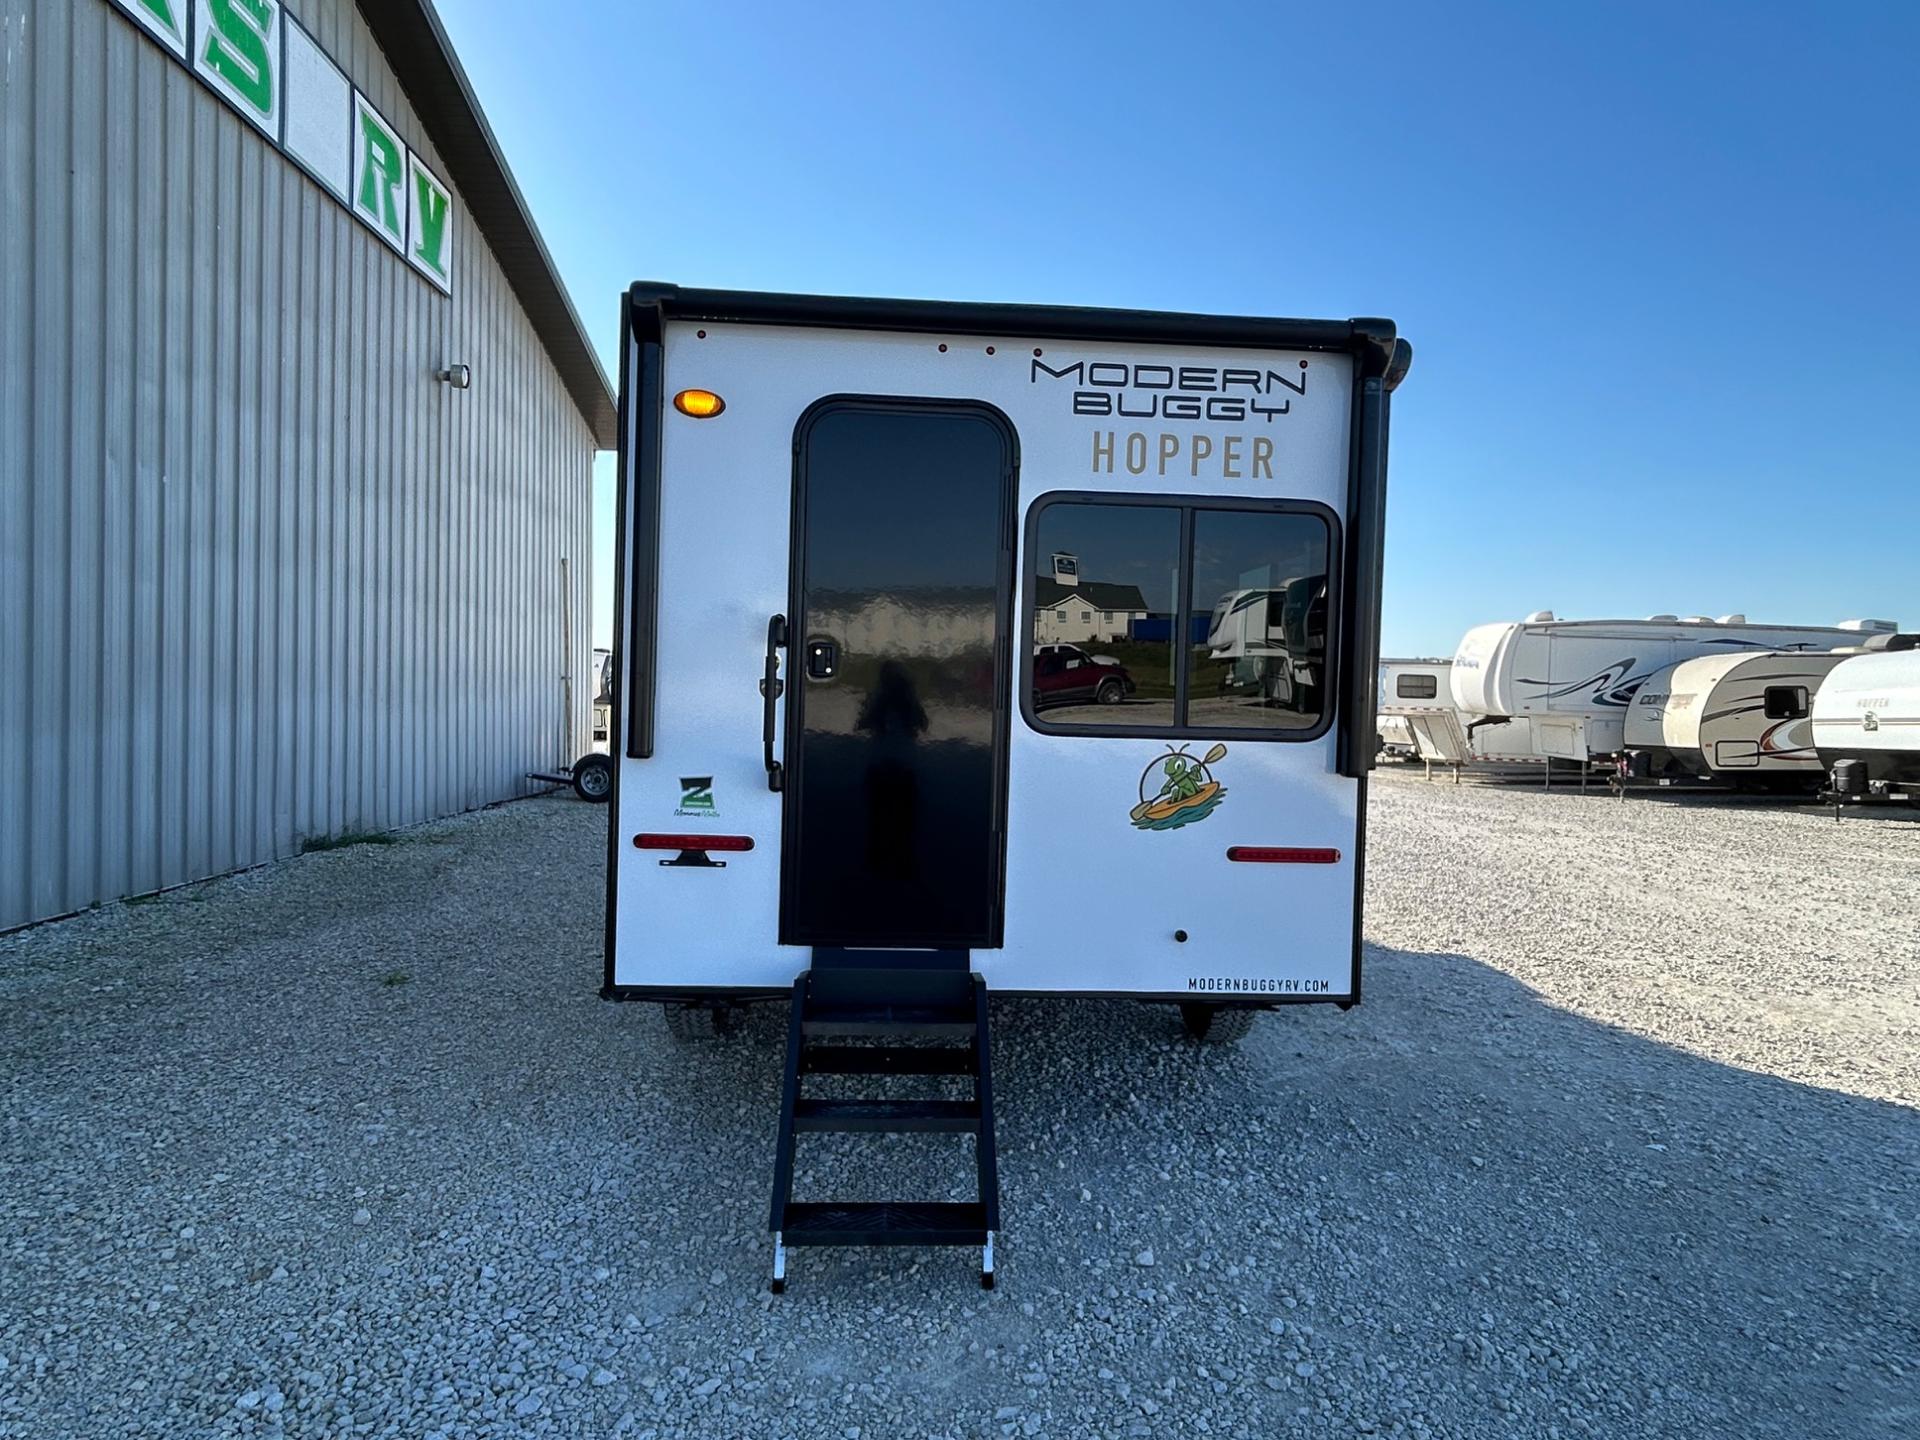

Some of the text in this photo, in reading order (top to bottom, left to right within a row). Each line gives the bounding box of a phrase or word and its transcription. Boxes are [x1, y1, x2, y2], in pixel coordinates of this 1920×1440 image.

[1031, 358, 1306, 396] MODERN
[1072, 391, 1290, 423] BUGGY
[1092, 430, 1274, 480] HOPPER
[1188, 977, 1329, 993] MODERNBUGGYRV.COM
